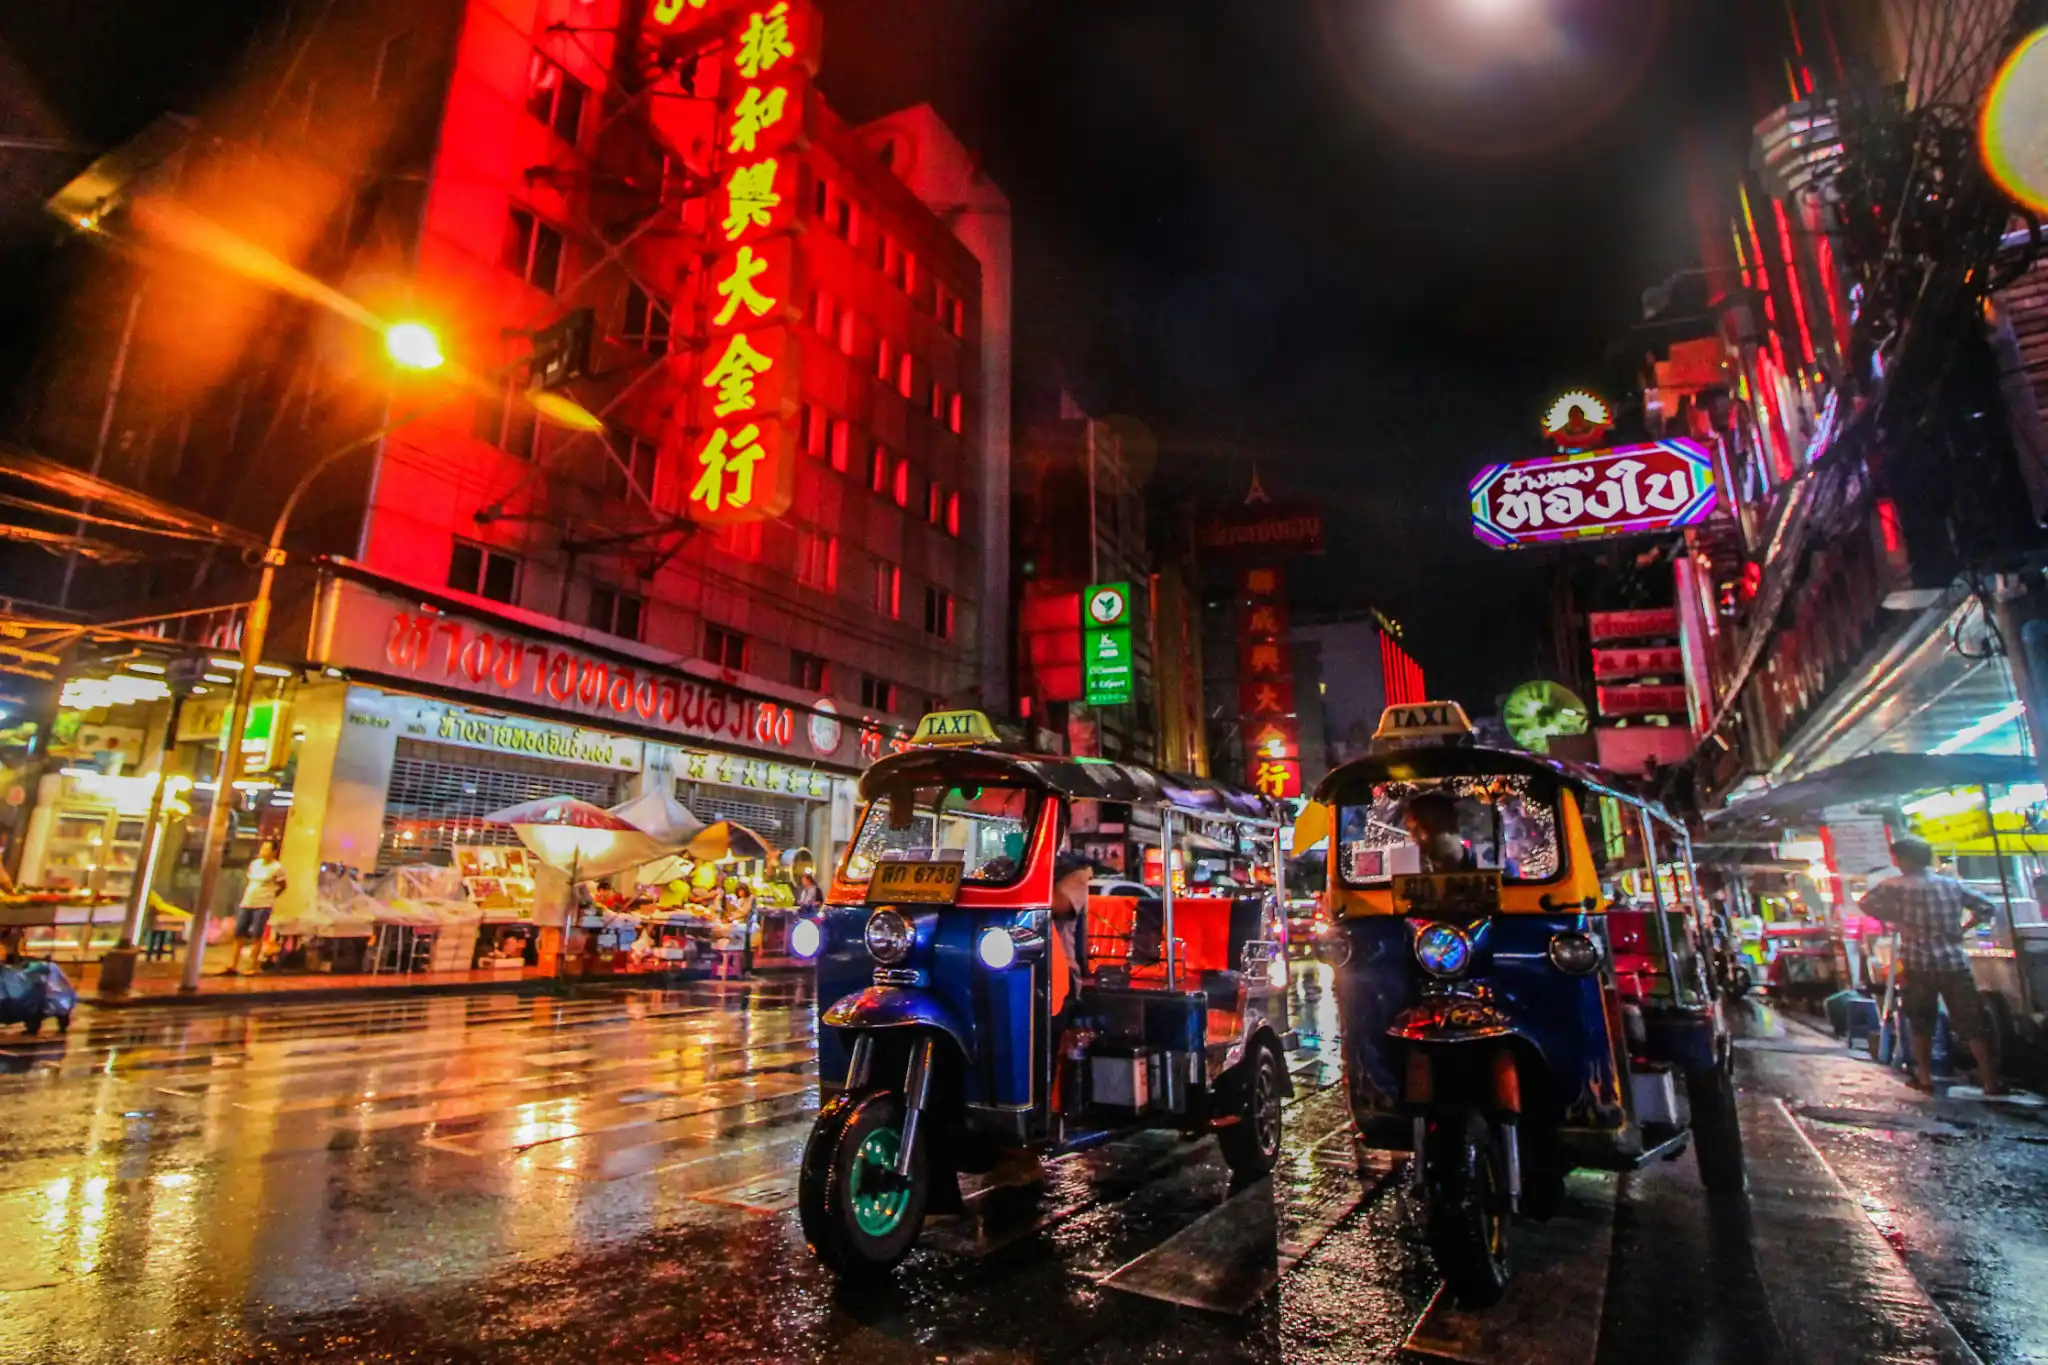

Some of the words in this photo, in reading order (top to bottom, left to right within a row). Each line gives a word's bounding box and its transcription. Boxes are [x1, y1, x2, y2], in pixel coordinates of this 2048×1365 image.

[926, 715, 971, 735] TAXI
[1390, 706, 1450, 729] TAXI
[914, 866, 957, 885] 6738
